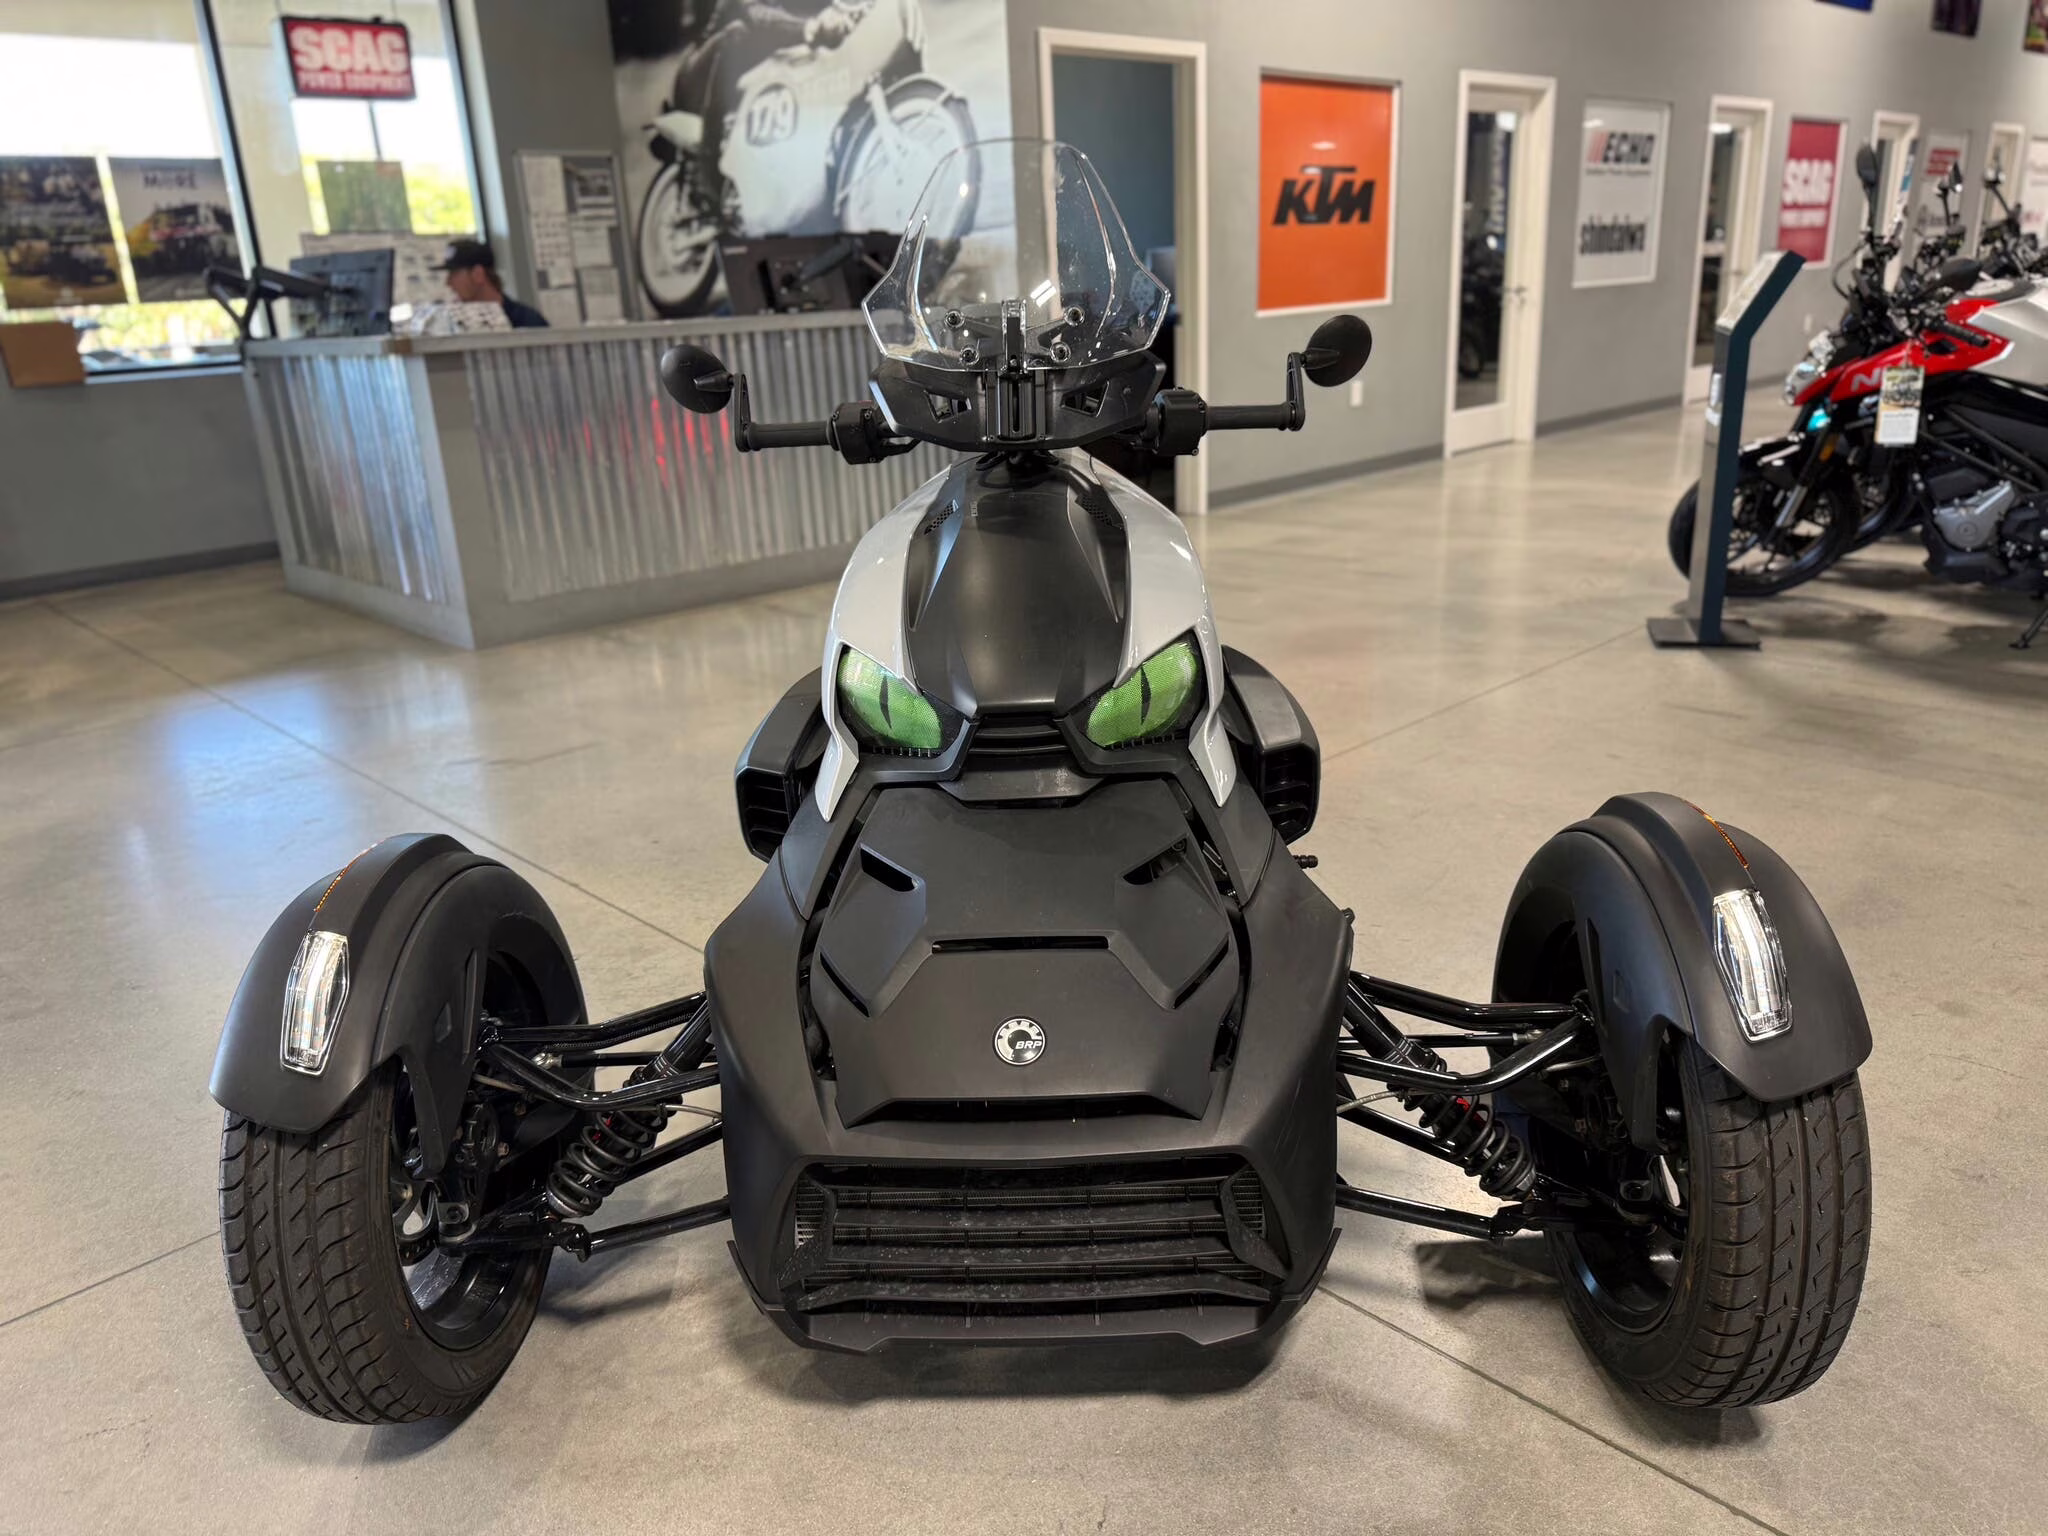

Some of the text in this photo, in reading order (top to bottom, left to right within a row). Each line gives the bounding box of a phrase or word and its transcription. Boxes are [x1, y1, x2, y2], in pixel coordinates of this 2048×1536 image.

[290, 26, 407, 71] SCAG
[1602, 131, 1655, 164] ECHO
[1271, 165, 1376, 225] KTM
[1782, 158, 1834, 206] SCAG
[1015, 1040, 1042, 1049] BRP
